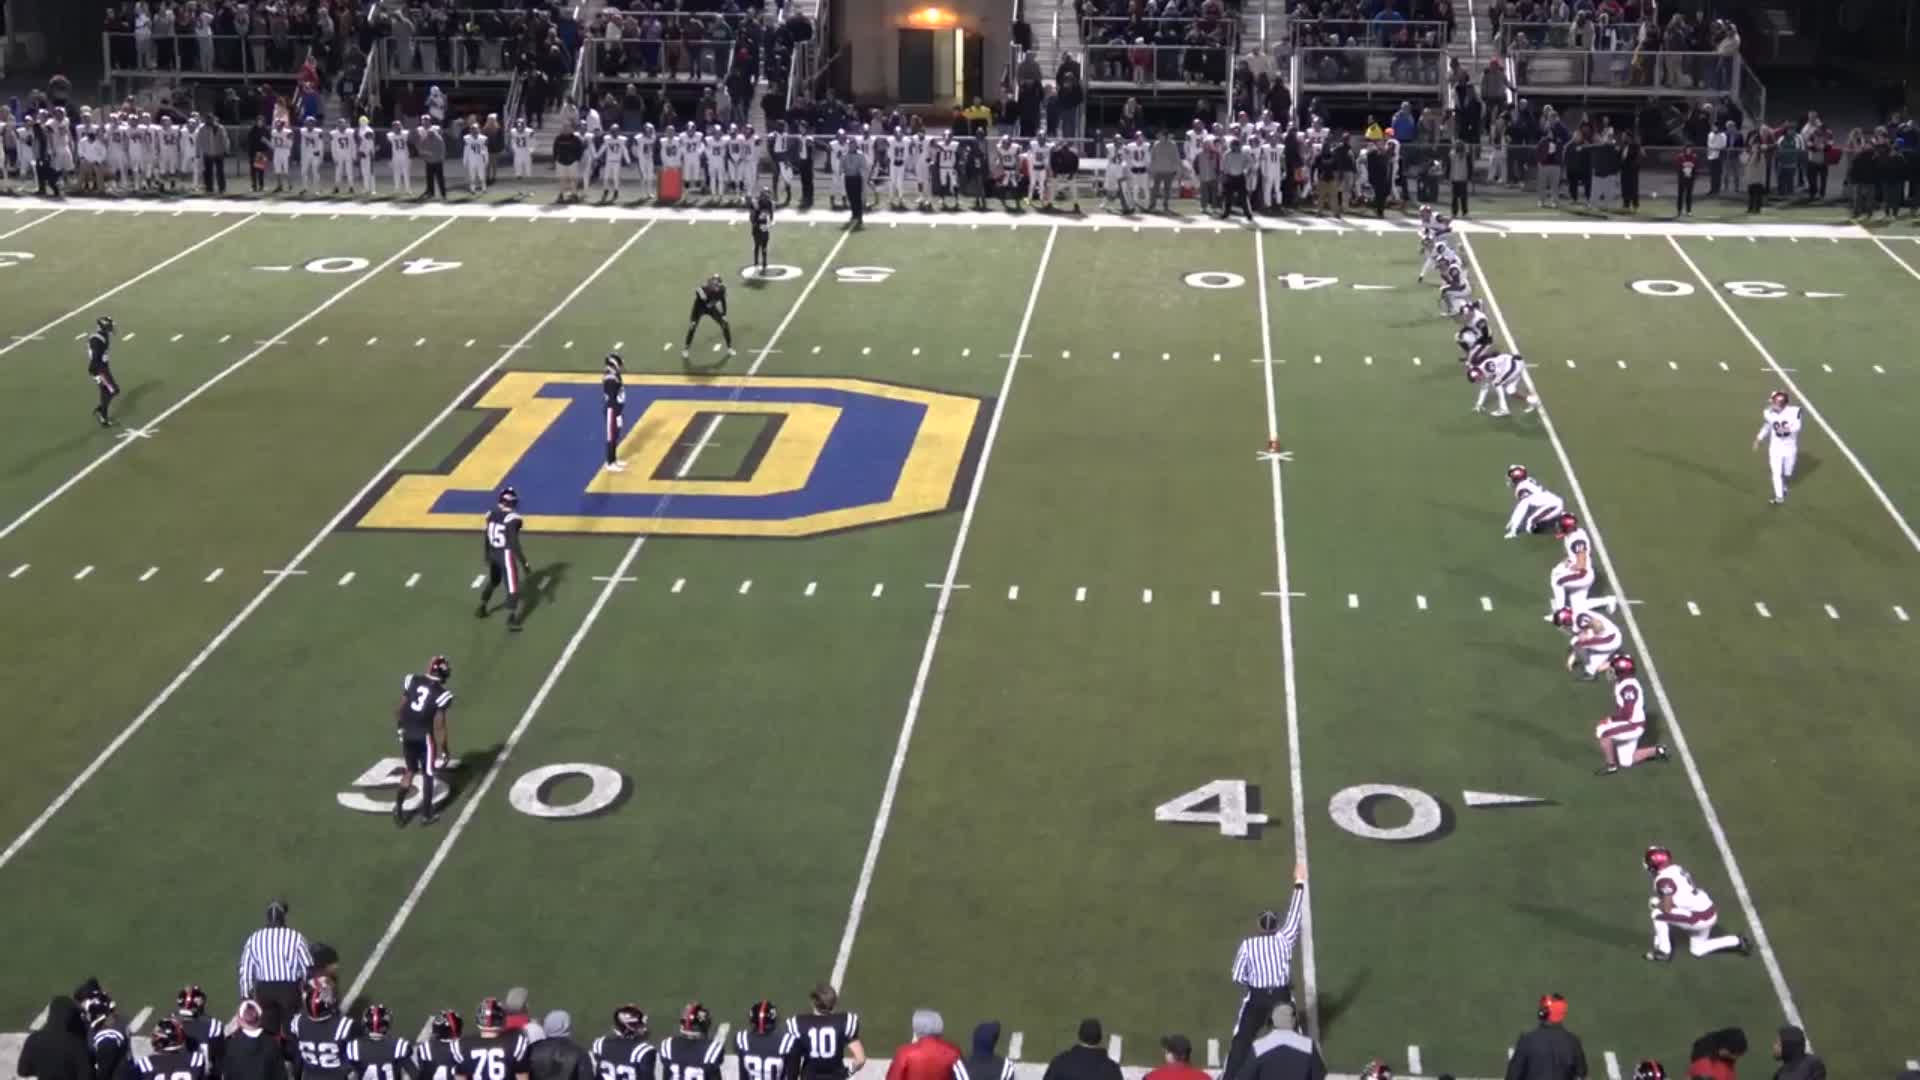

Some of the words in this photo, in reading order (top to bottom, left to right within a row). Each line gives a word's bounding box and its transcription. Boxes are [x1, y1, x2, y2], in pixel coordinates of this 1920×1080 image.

[411, 687, 430, 711] 3
[299, 1041, 341, 1068] 62
[808, 1027, 836, 1058] 10
[471, 1048, 505, 1080] 76
